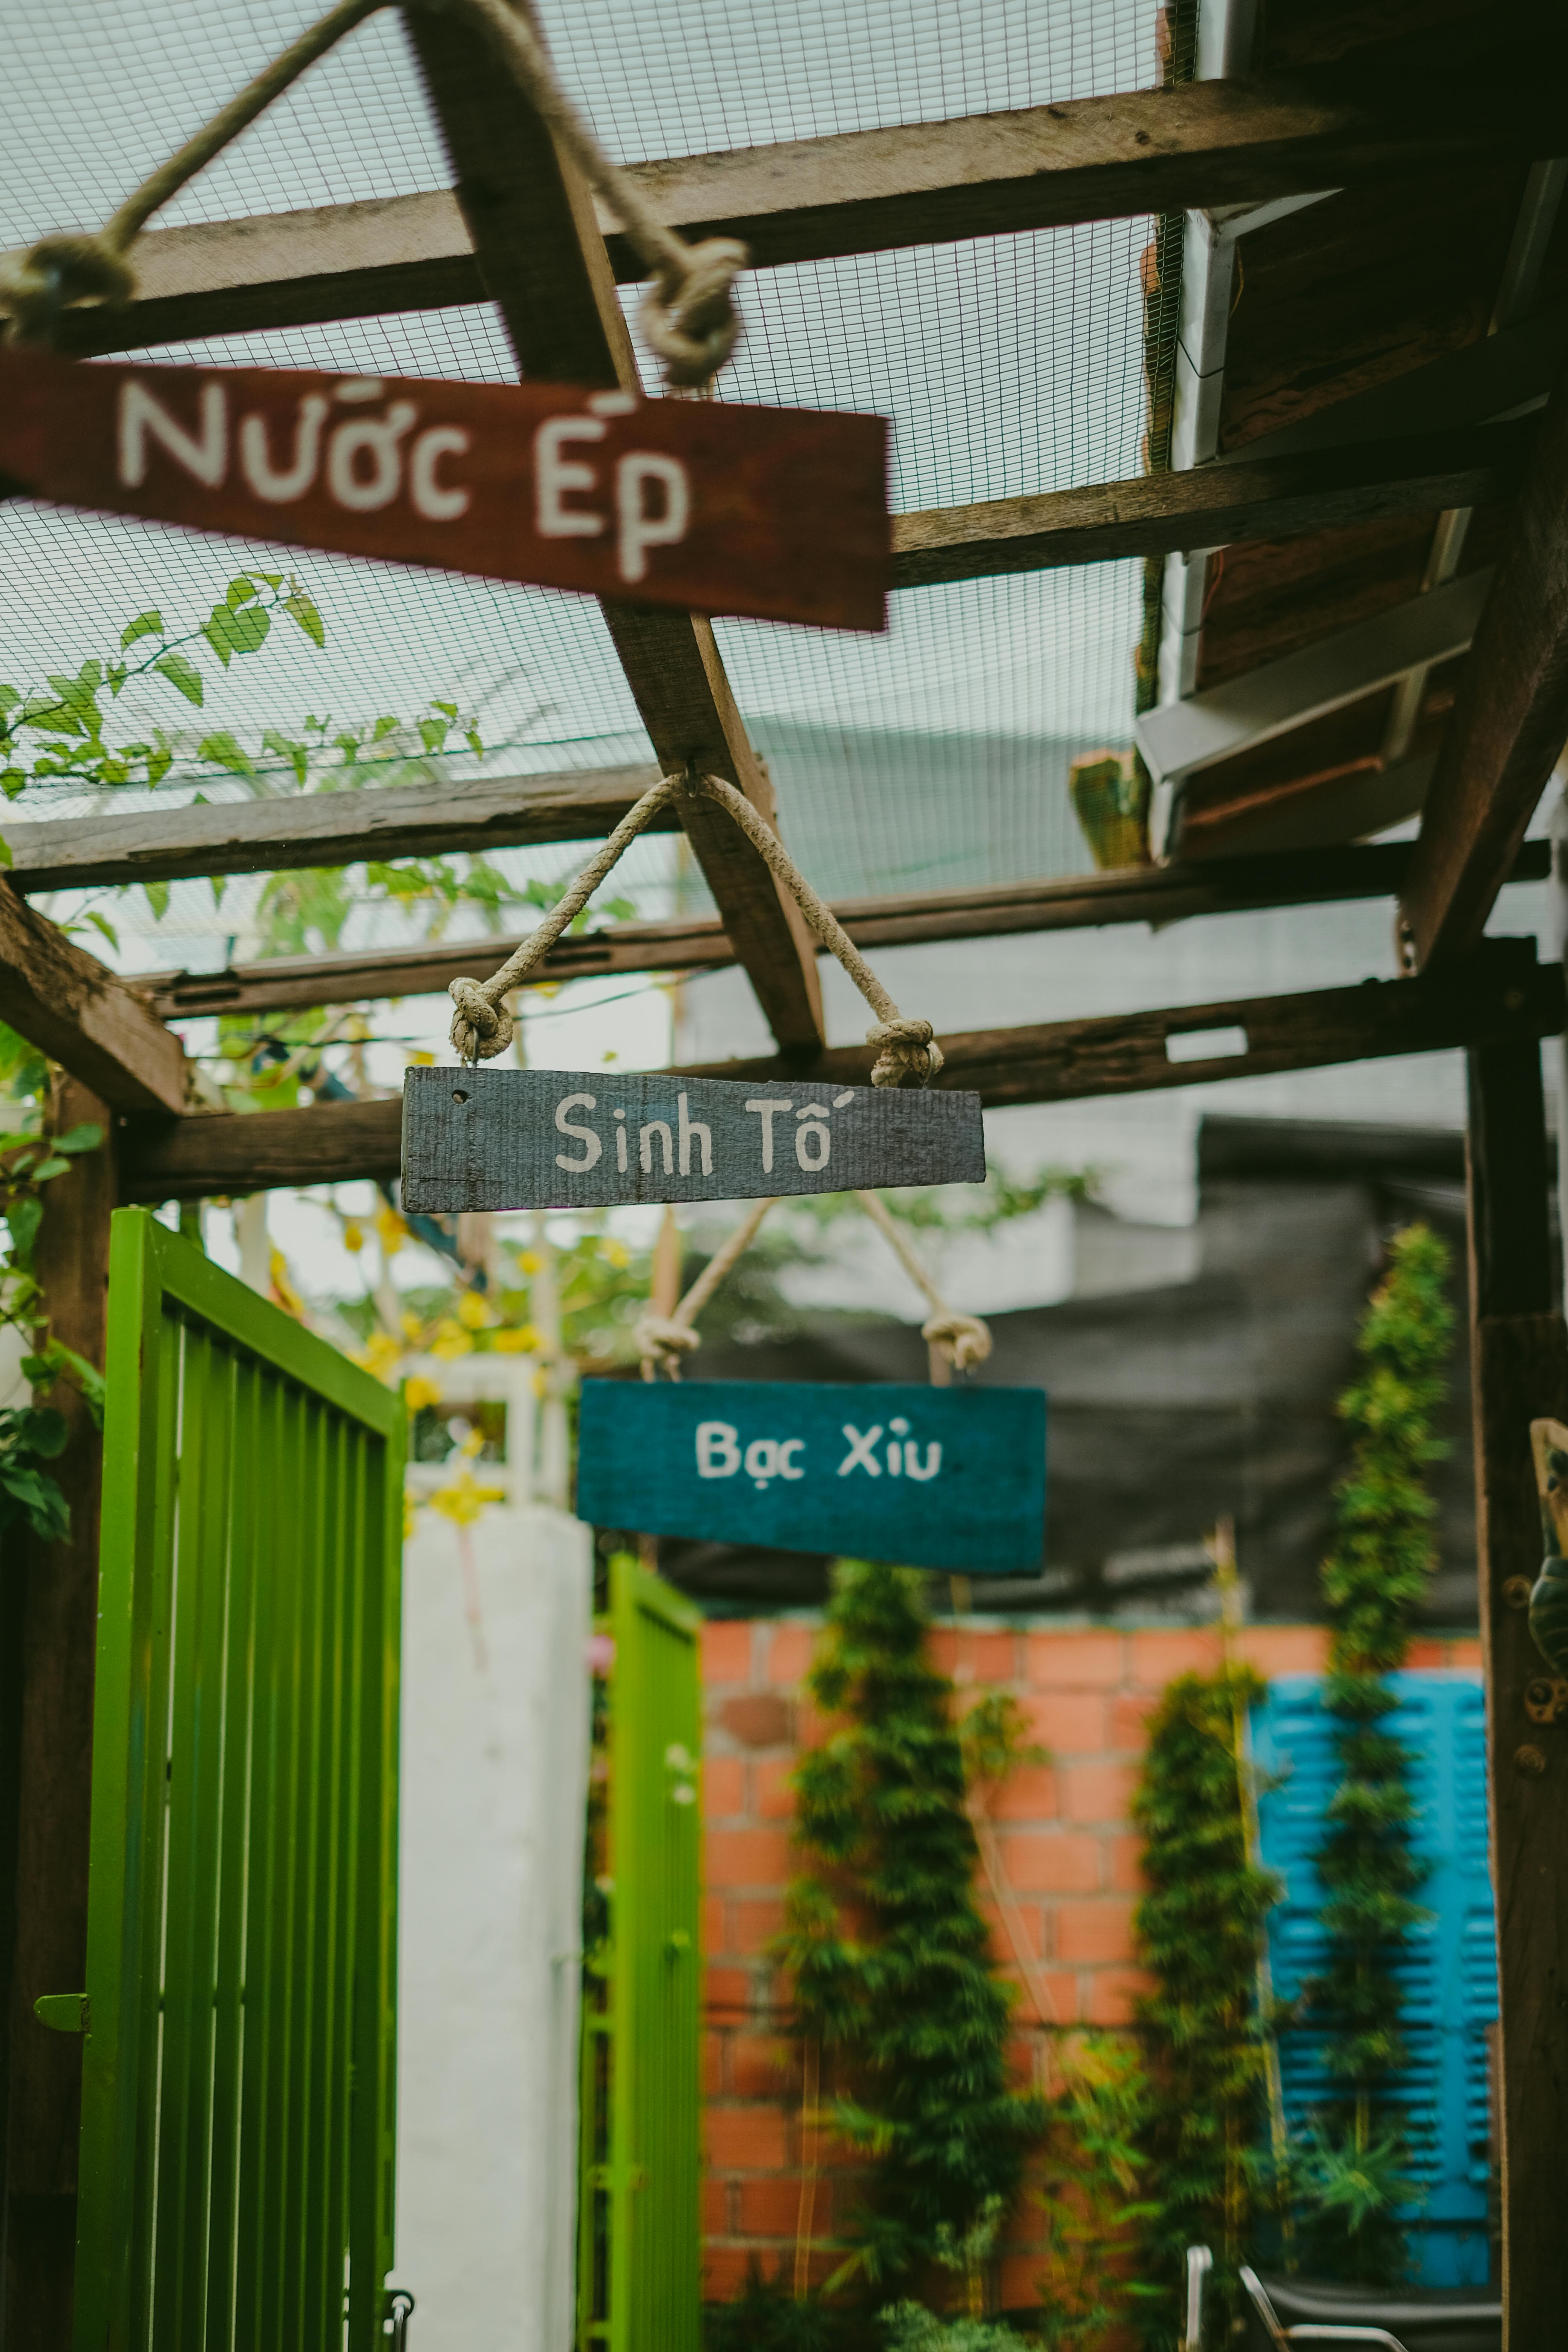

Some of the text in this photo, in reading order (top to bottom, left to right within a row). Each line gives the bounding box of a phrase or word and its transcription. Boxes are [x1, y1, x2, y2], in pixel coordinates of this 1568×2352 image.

[121, 378, 689, 581] Nước Ép
[555, 1091, 854, 1176] Sinh Tố
[696, 1422, 804, 1489] Bạc
